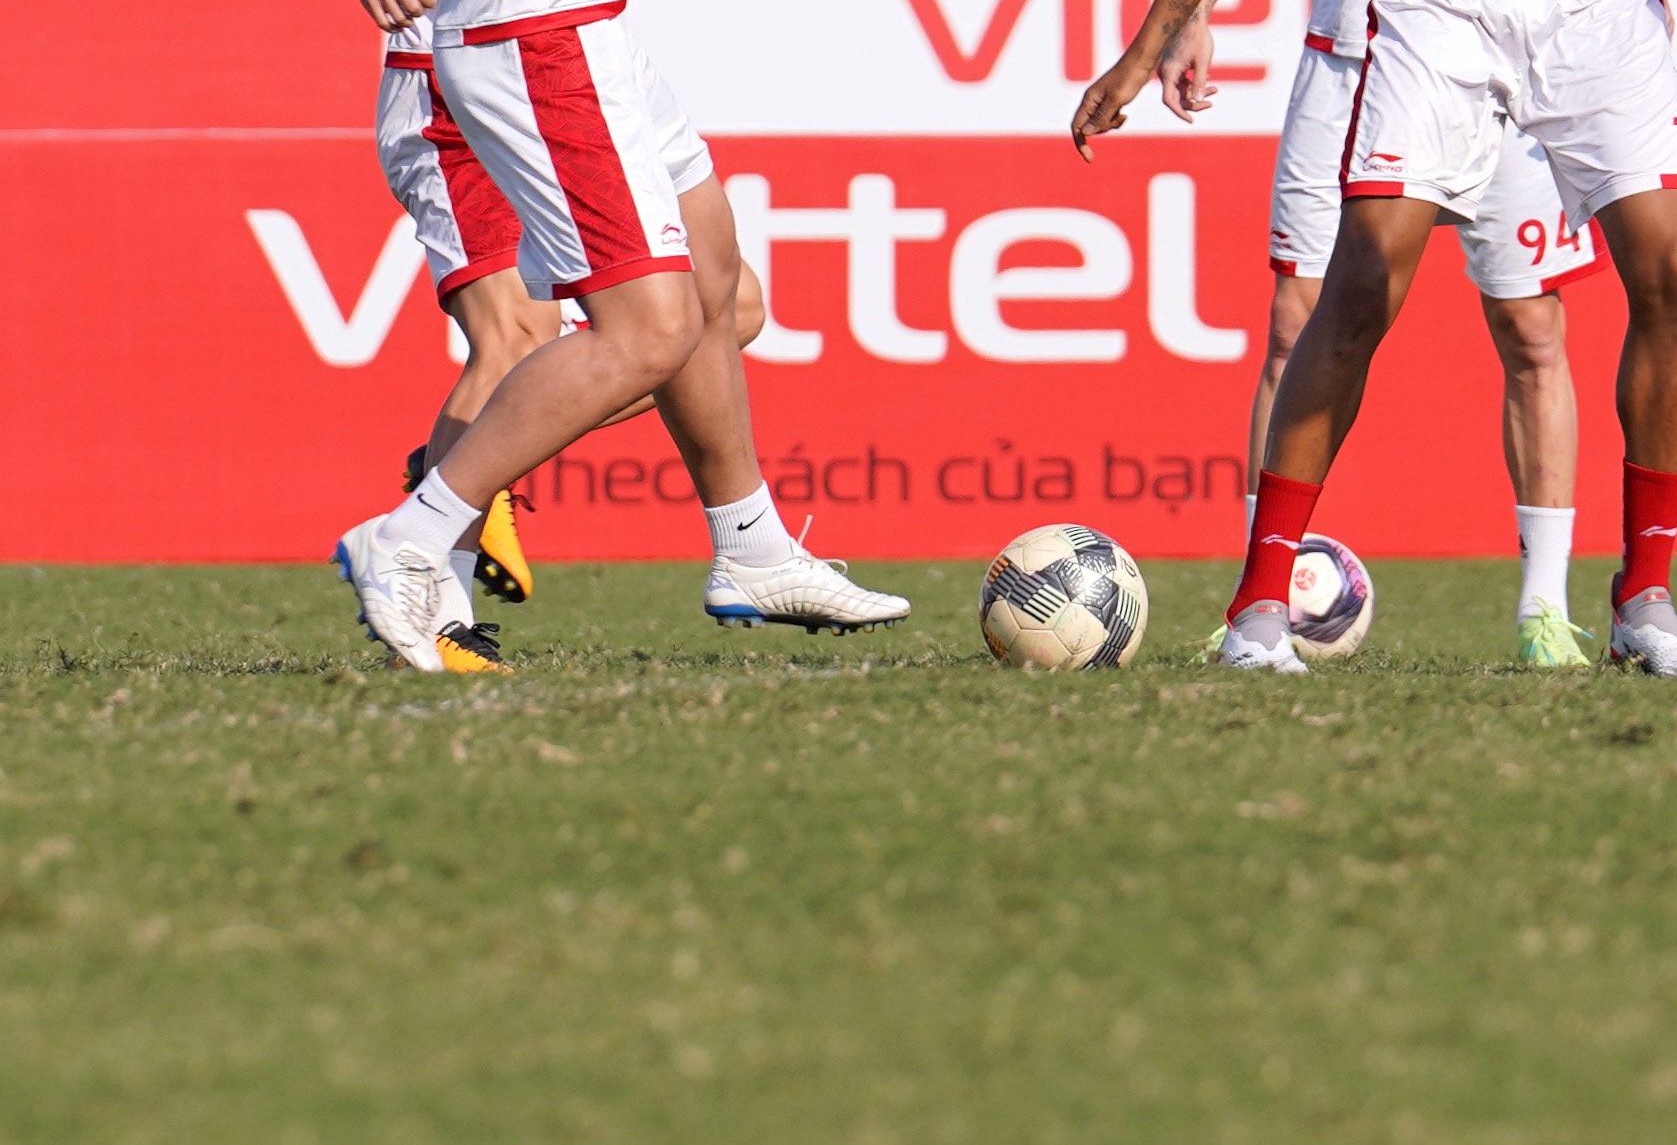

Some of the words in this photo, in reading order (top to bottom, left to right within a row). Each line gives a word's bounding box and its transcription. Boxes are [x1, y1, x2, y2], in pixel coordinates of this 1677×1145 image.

[246, 173, 1248, 366] vttel
[1517, 210, 1581, 266] 94
[759, 442, 909, 502] ách
[938, 438, 1075, 502] của
[1103, 443, 1244, 514] bạn
